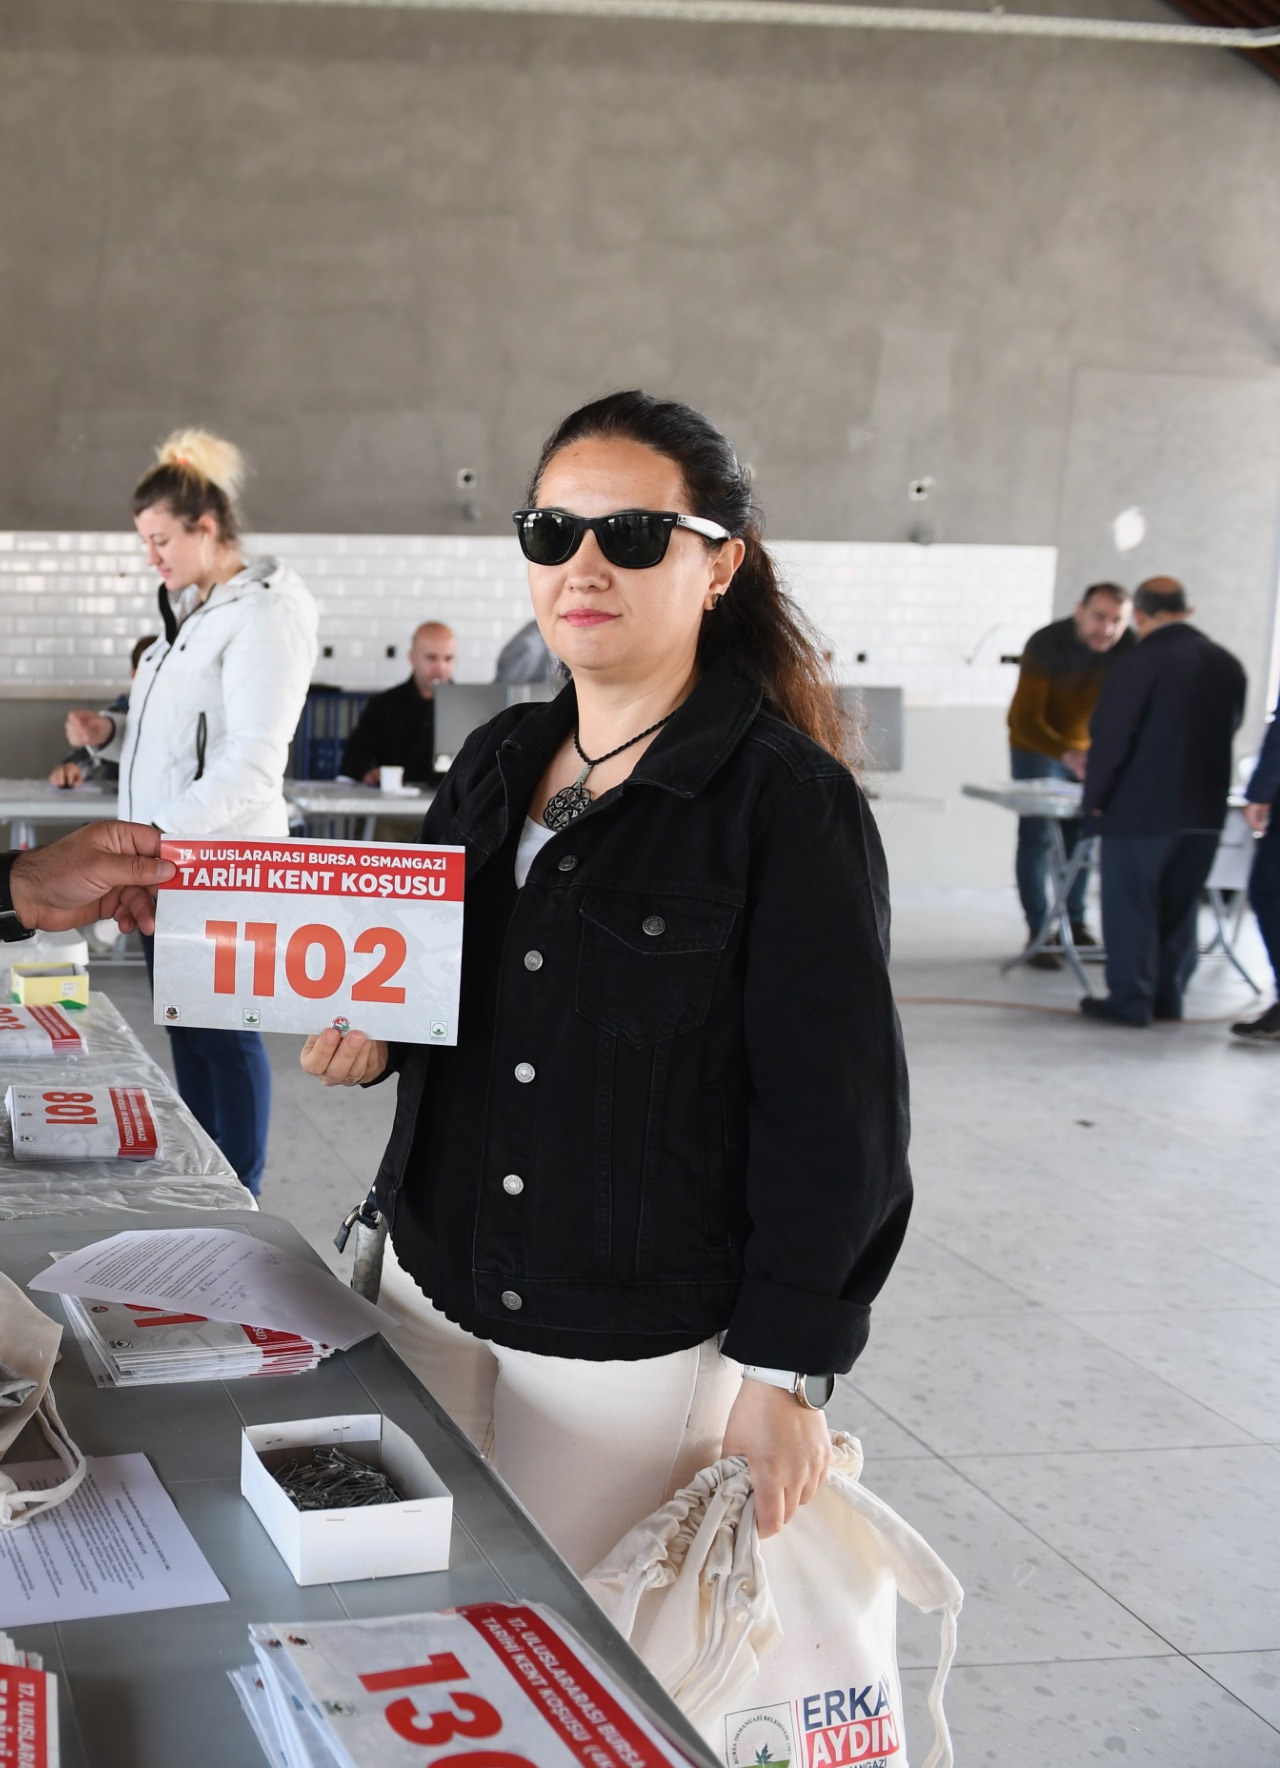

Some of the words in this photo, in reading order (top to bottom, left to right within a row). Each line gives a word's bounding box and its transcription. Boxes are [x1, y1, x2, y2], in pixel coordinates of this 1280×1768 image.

[180, 863, 260, 888] TARİHİ
[267, 868, 334, 891] KENT
[341, 872, 446, 897] KOŞUSU
[200, 849, 305, 863] ULUSLARARASI
[308, 852, 356, 866] BURSA
[360, 855, 447, 871] OSMANGAZİ
[205, 920, 407, 1004] 1102
[42, 1091, 98, 1124] 801
[18, 1682, 35, 1699] 17.
[481, 1616, 521, 1654] TARİHİ
[511, 1653, 549, 1687] KENT
[538, 1686, 592, 1742] KOŞUSU
[507, 1616, 528, 1632] 17.
[521, 1631, 608, 1725] ULUSLARARASI
[812, 1714, 898, 1768] AYDIN
